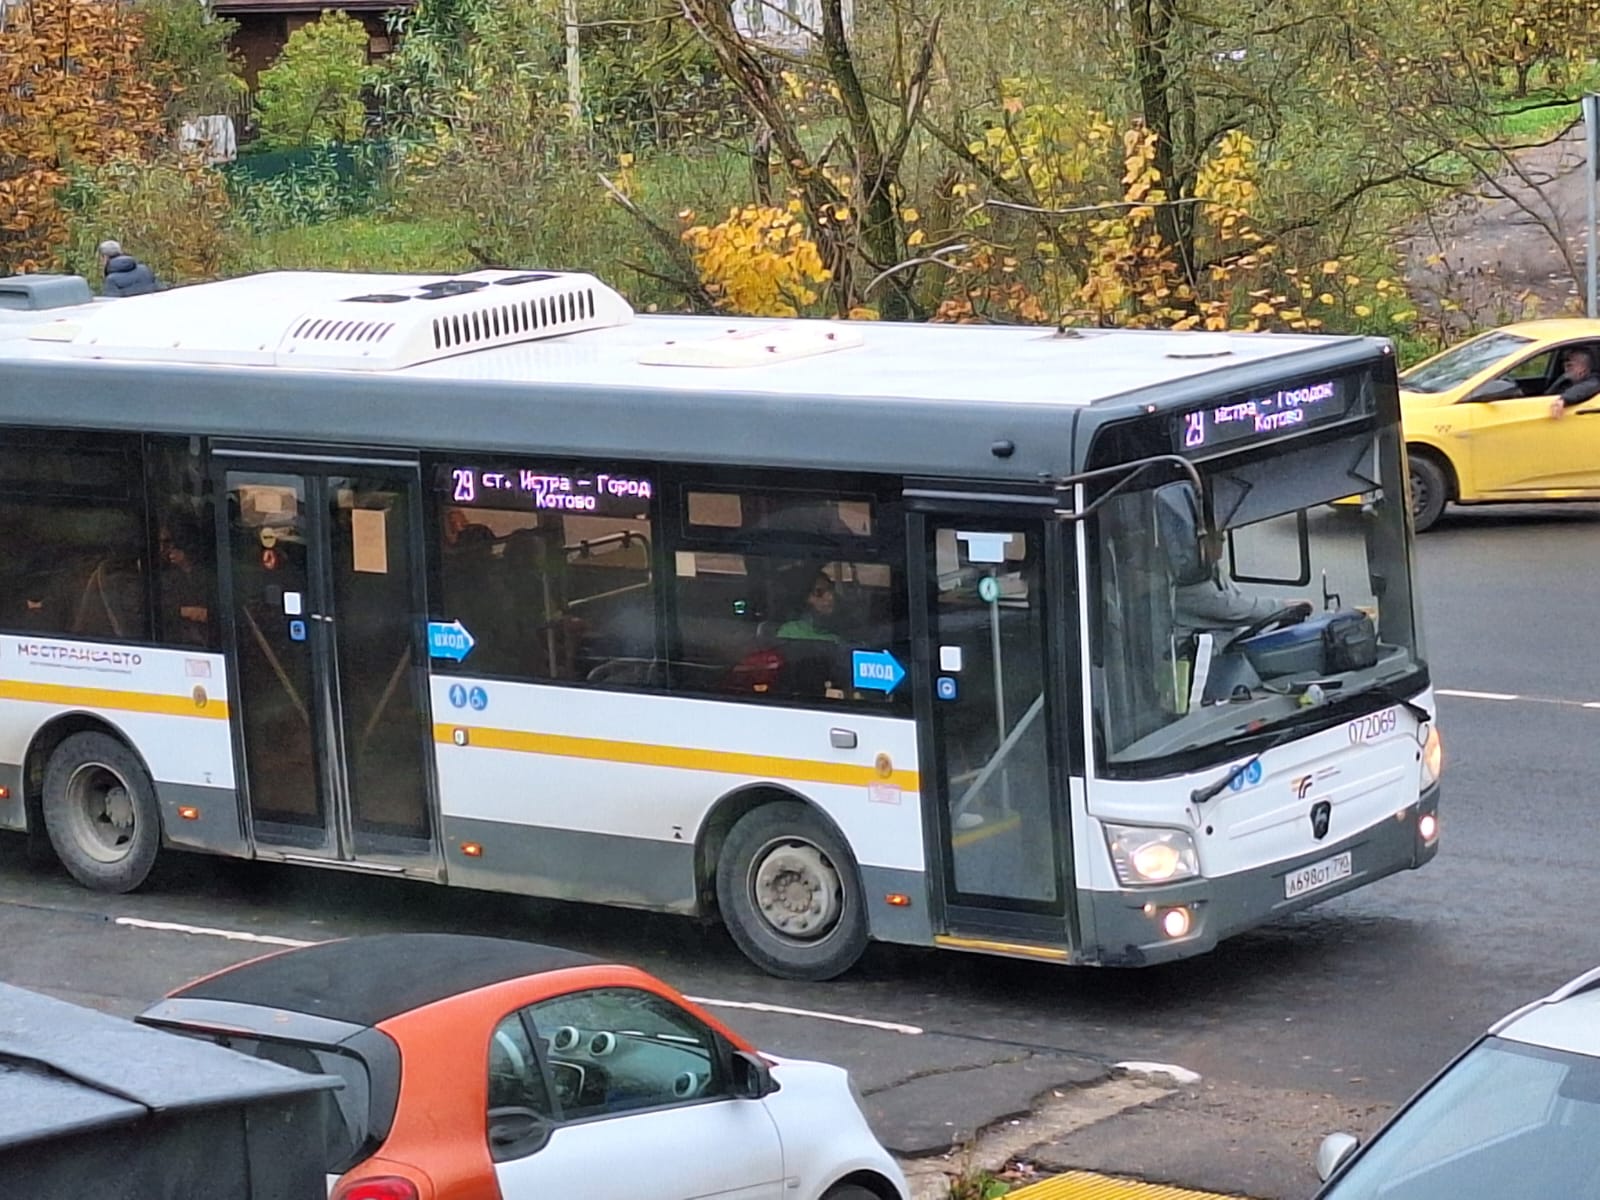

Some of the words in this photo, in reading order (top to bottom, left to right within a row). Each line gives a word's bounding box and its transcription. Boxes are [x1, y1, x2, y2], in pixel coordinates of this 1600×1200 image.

[452, 469, 475, 501] 29
[482, 473, 512, 489] ст.
[519, 469, 571, 492] Истра
[596, 474, 651, 499] Город
[535, 489, 596, 510] Котово
[859, 662, 894, 682] ВХОД
[1348, 709, 1397, 745] 072069
